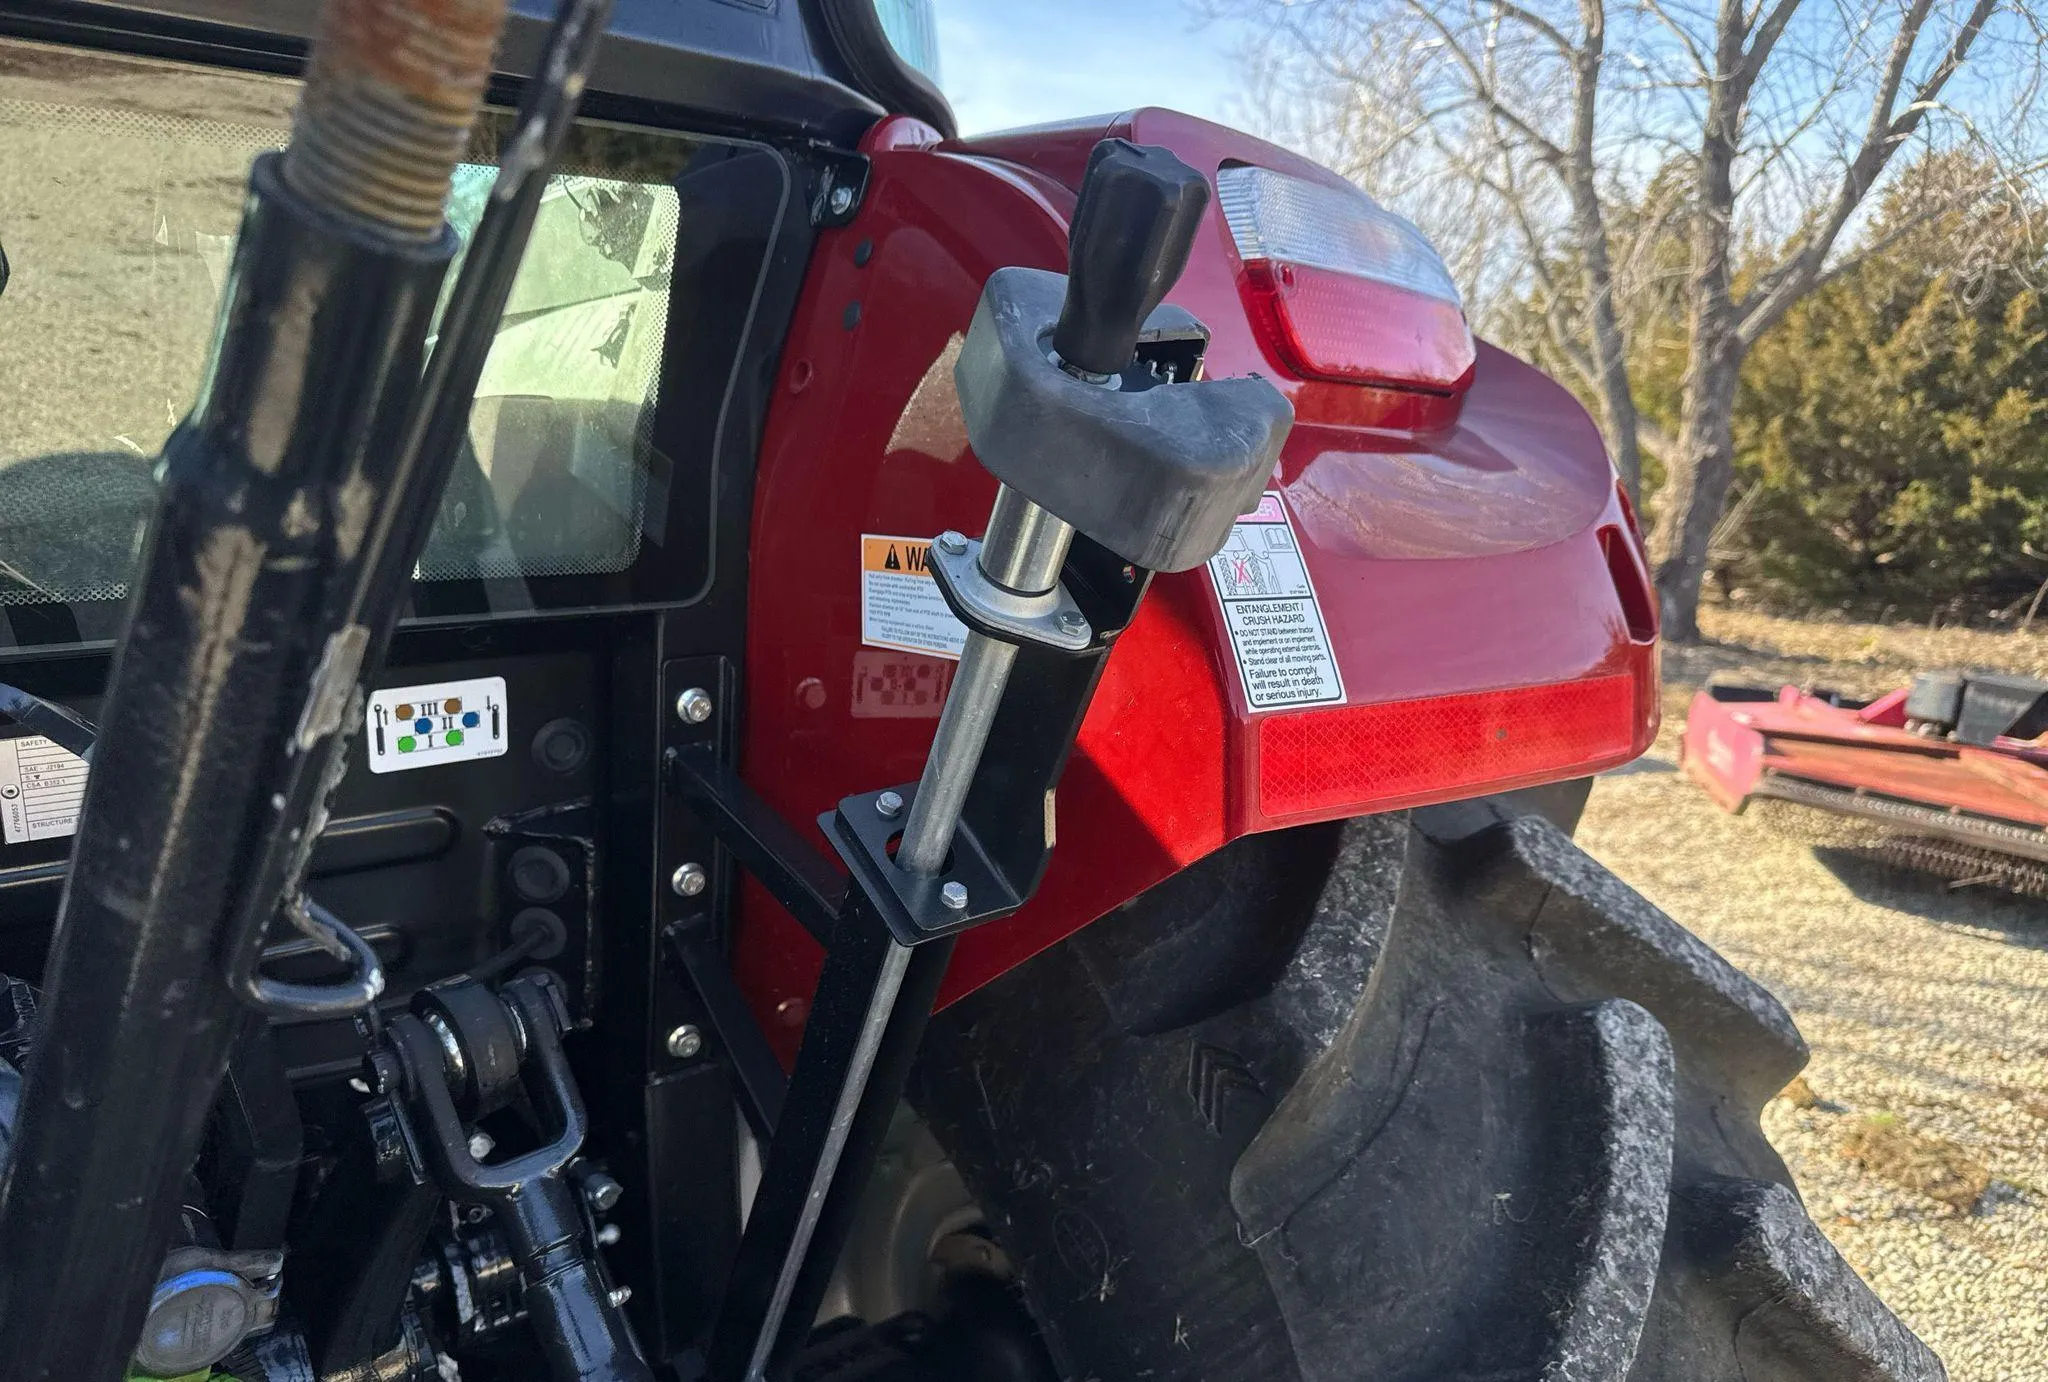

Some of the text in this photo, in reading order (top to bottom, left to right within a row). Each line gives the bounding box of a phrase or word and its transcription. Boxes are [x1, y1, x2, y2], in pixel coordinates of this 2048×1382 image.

[1236, 602, 1299, 615] ENTANGLEMENT
[1242, 614, 1305, 626] CRUSH HAZARD
[1240, 629, 1247, 637] DO
[1248, 628, 1261, 637] NOT
[1260, 628, 1278, 636] STAND
[1248, 656, 1264, 666] Stand
[1265, 655, 1278, 664] clear
[1292, 654, 1312, 663] moving
[1249, 665, 1318, 679] Failure to comply
[1252, 675, 1324, 690] will result in death
[1255, 687, 1322, 701] or serious injury.
[421, 702, 438, 716] III
[442, 716, 453, 730] II
[21, 739, 47, 748] SAFETY
[428, 734, 433, 748] I
[32, 817, 74, 829] STRUCTURE
